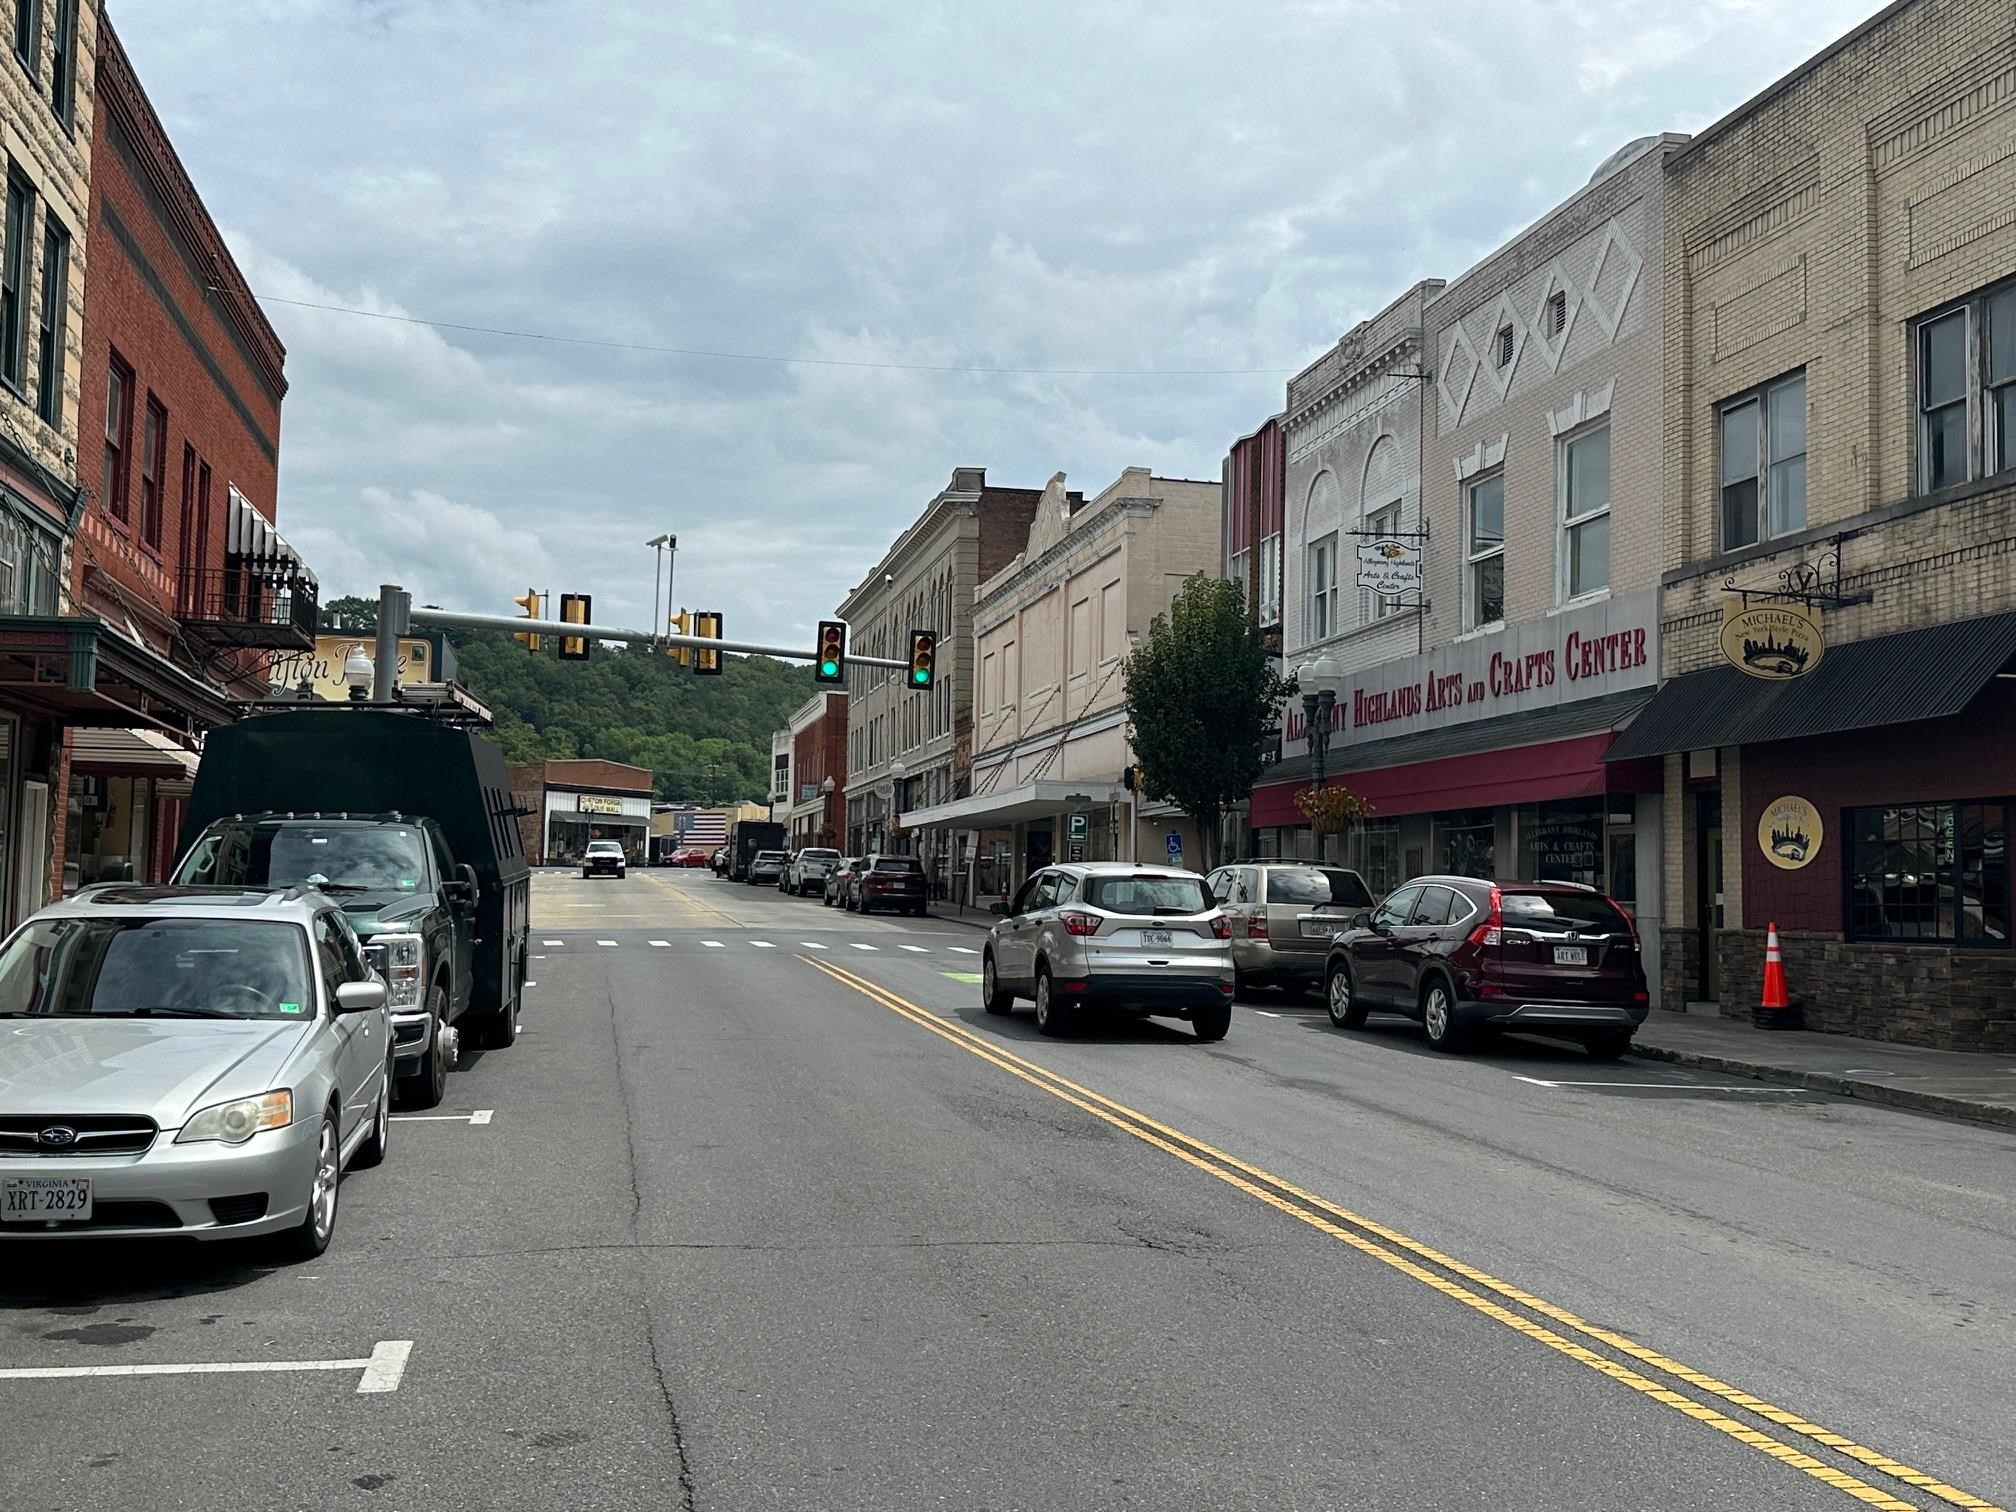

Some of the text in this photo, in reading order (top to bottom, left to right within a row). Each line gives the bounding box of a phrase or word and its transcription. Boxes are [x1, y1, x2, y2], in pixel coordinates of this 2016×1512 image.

[1363, 571, 1415, 582] Arts & Crafts
[1376, 580, 1400, 590] Center
[267, 648, 330, 695] lifton
[1286, 627, 1648, 743] ALLNY HIGHLANDS ARTS AND CRAFTS CENTER
[1071, 816, 1085, 832] P
[1530, 842, 1594, 851] ARTS & CRAFTS
[1557, 951, 1568, 960] ART
[26, 1179, 69, 1188] VIRGINIA
[8, 1189, 87, 1210] XRT-2829
